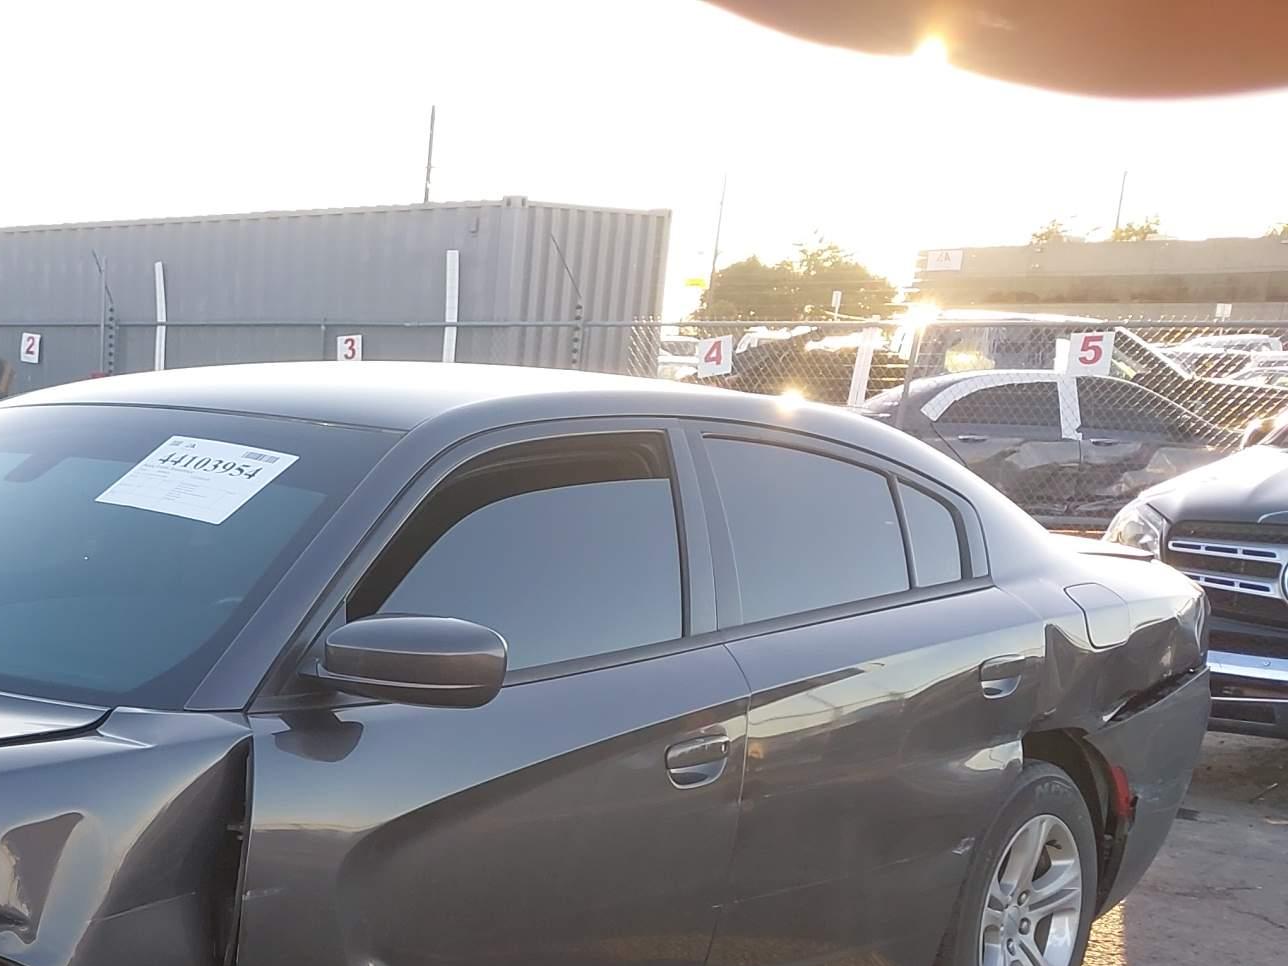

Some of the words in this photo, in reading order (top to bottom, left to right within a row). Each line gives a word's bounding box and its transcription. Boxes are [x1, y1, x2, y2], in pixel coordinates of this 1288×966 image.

[25, 336, 35, 355] 2
[344, 338, 356, 360] 3
[704, 340, 722, 365] 4
[1078, 335, 1104, 365] 5
[158, 452, 263, 480] 44103954
